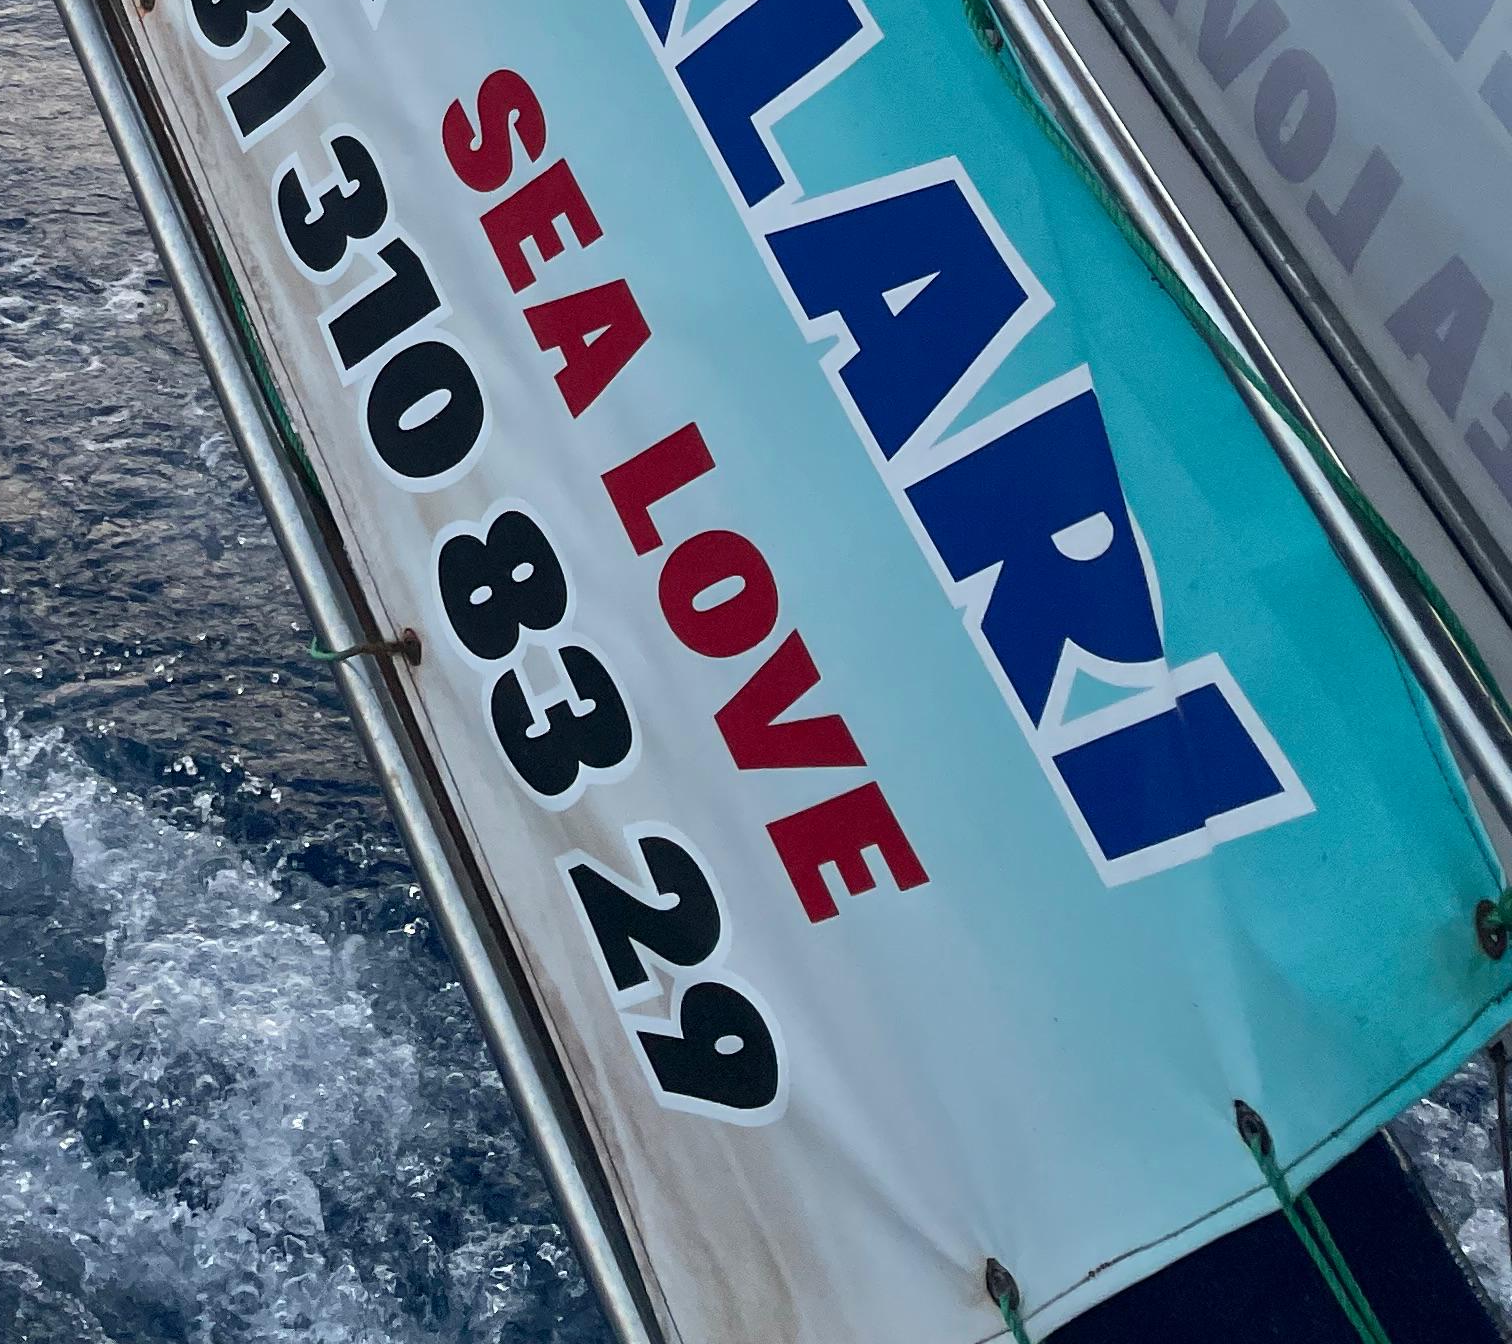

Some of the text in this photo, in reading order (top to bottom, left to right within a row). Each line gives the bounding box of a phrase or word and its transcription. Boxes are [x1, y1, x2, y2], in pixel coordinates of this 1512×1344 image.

[277, 134, 485, 479] 310
[437, 510, 633, 798] 83
[567, 835, 779, 1111] 29
[441, 68, 930, 924] SEA LOVE
